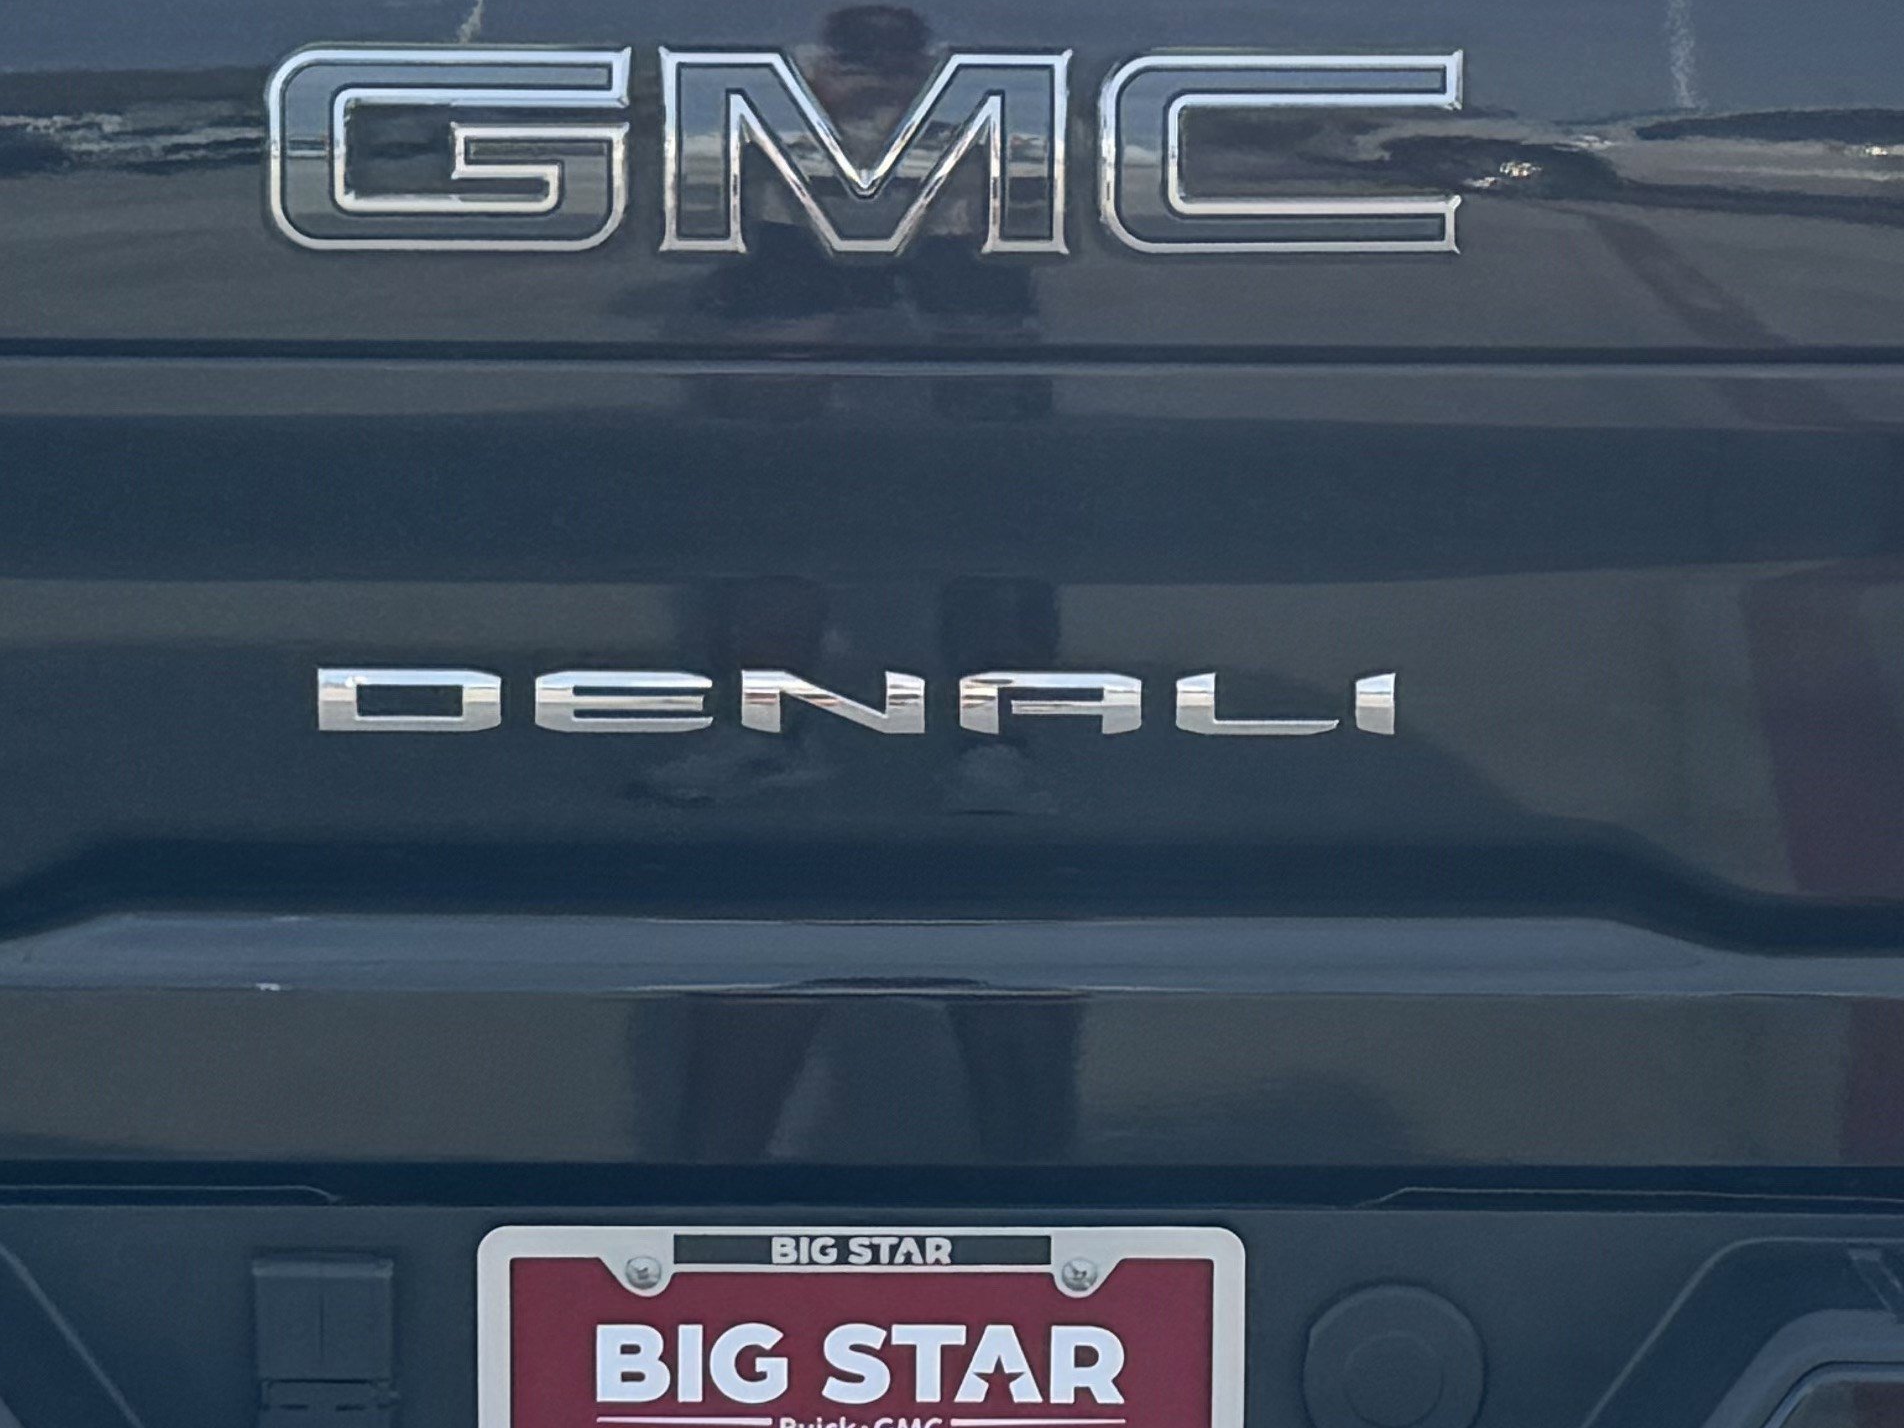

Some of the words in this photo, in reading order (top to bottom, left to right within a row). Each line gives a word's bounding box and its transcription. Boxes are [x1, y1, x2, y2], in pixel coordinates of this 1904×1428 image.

[268, 44, 1463, 256] GMC
[317, 667, 1396, 734] DENALI
[771, 1236, 837, 1265] BIG
[848, 1236, 953, 1266] STAR
[596, 1323, 789, 1405] BIG
[822, 1323, 1126, 1406] STAR
